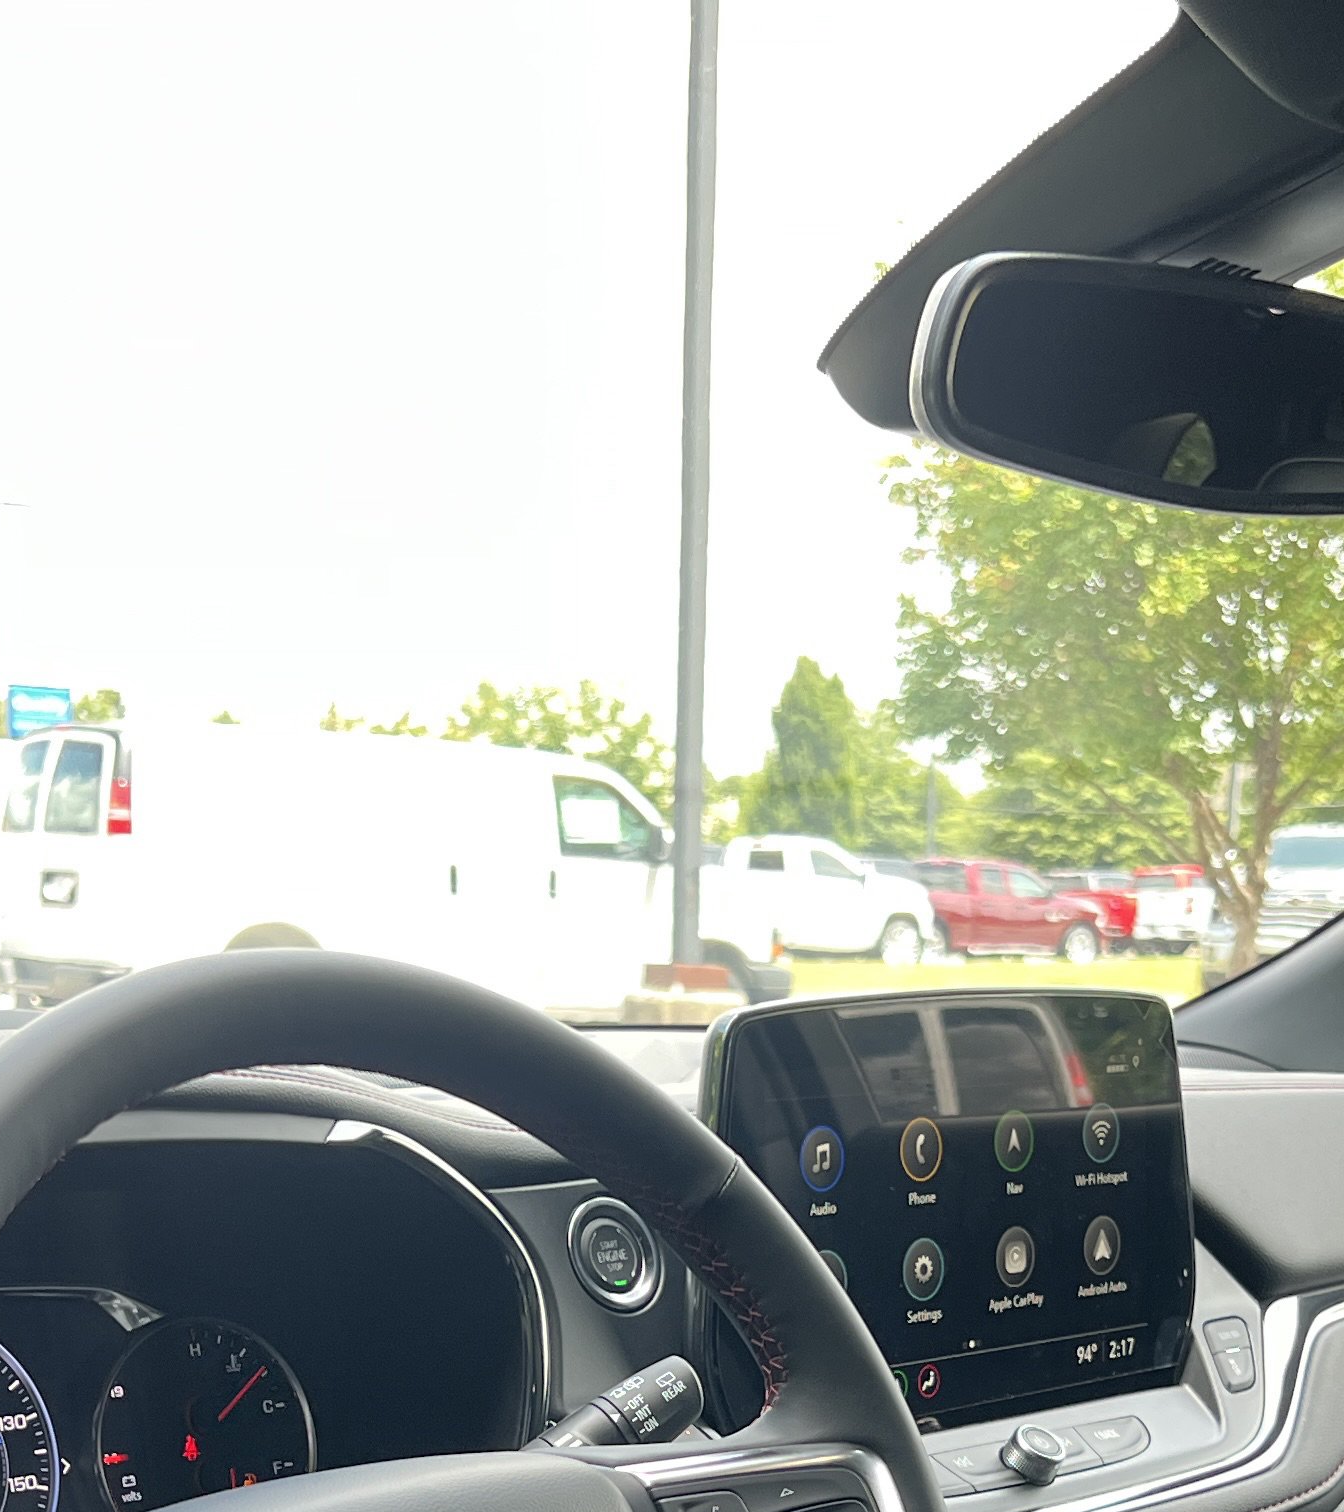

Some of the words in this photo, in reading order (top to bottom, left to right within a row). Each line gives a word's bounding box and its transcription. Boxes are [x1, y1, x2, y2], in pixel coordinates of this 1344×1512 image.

[1097, 1171, 1128, 1186] Hotspot
[1006, 1182, 1024, 1195] Nav
[908, 1192, 937, 1206] Phone
[809, 1202, 838, 1217] Audio
[989, 1297, 1012, 1313] Apple
[1013, 1292, 1044, 1309] CarPlay
[907, 1309, 943, 1324] Settings
[1109, 1337, 1135, 1358] 2:17
[661, 1380, 687, 1402] REAR
[643, 1415, 660, 1433] ON
[8, 1473, 38, 1493] 150
